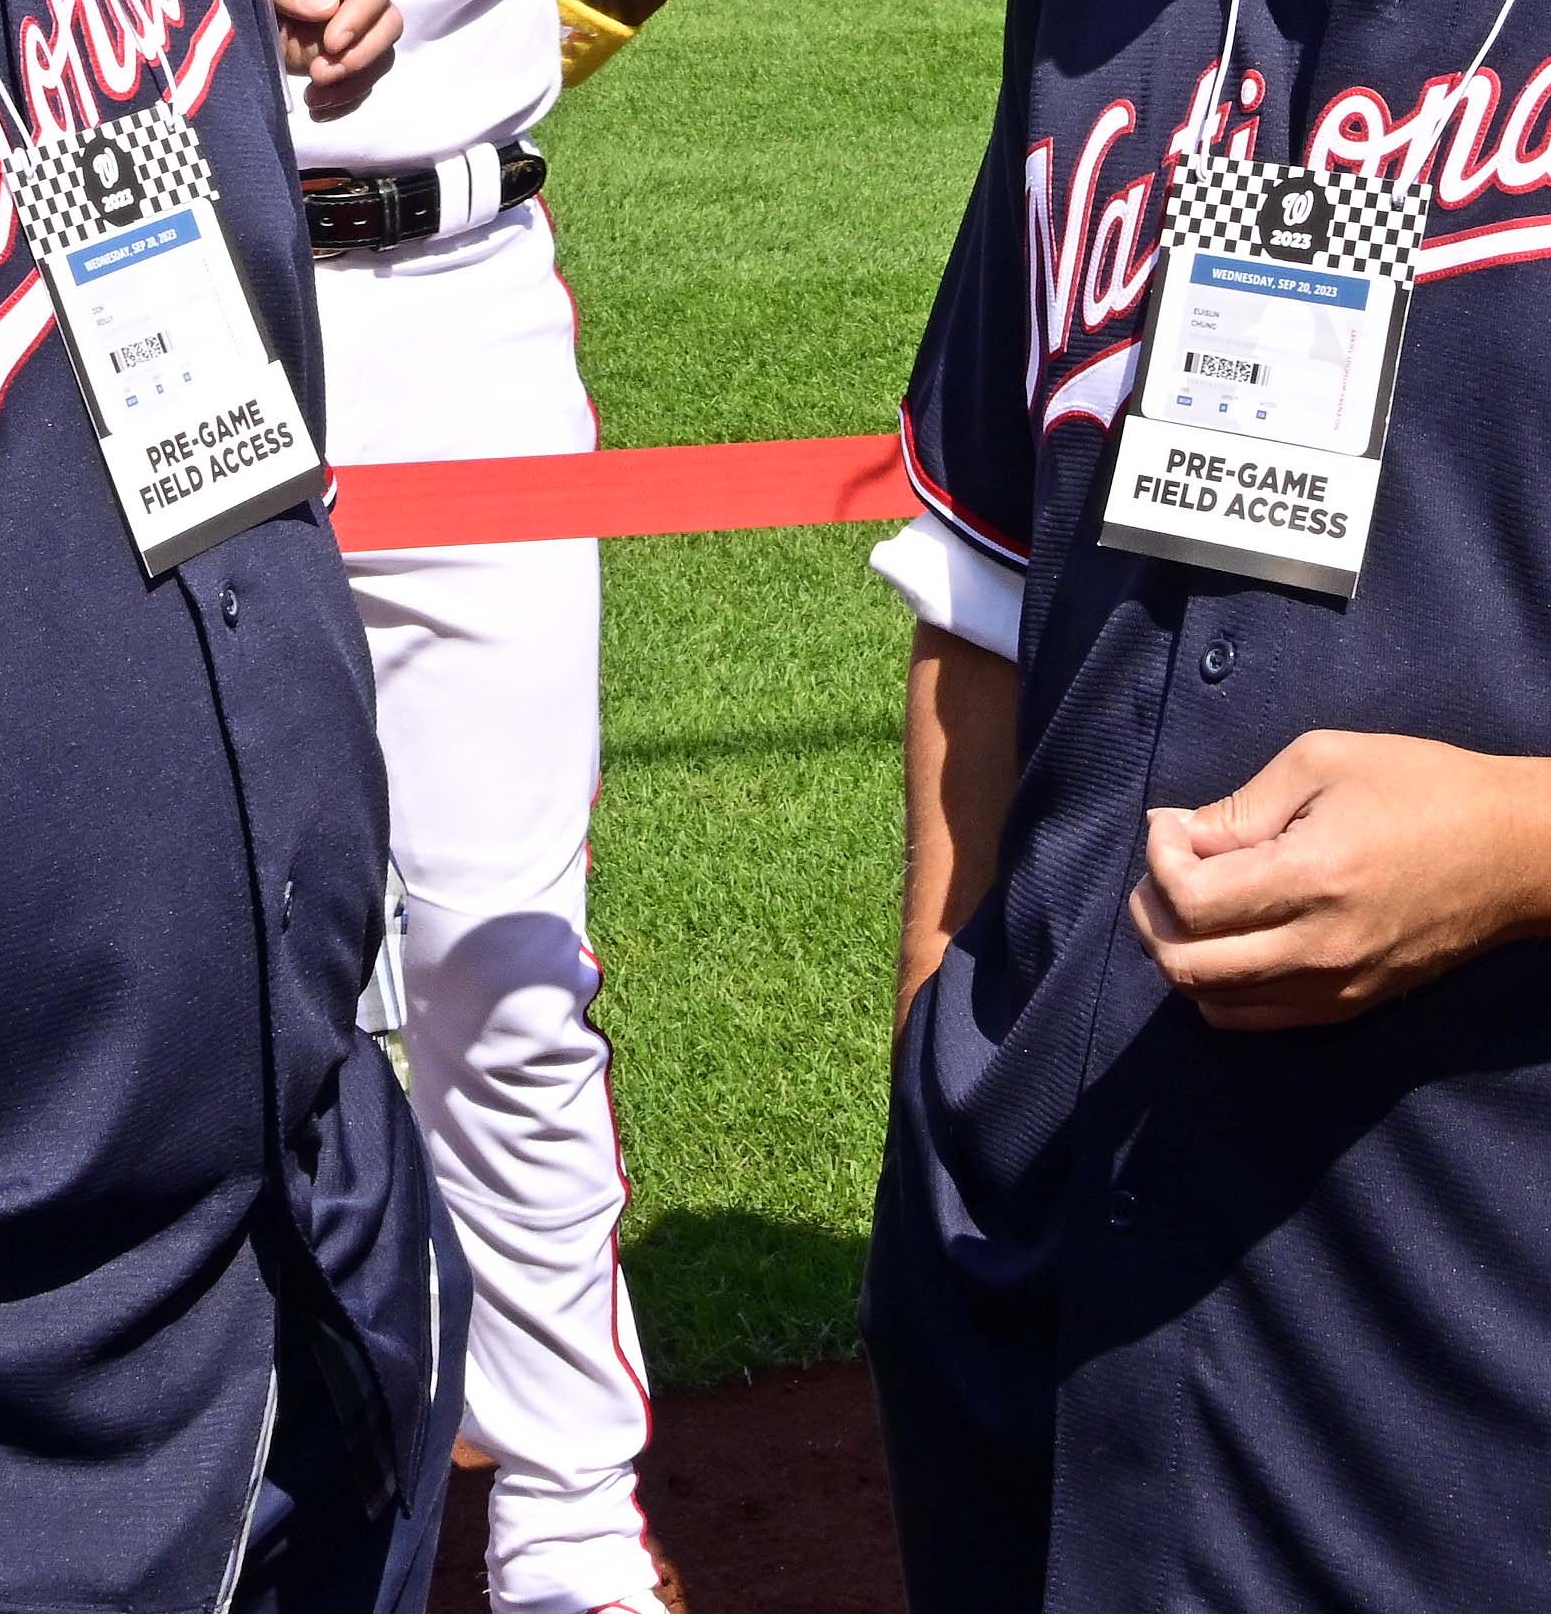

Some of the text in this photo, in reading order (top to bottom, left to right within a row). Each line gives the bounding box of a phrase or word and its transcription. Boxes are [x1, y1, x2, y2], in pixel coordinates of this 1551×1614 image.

[101, 188, 135, 213] 2023
[131, 240, 146, 254] SEP
[1270, 229, 1313, 251] 2023
[1212, 268, 1338, 298] WEDNESDAY, SEP 20, 2023
[145, 399, 265, 474] PRE-GAME
[138, 422, 295, 515] FIELD ACCESS
[1165, 448, 1329, 503] PRE-GAME
[1133, 473, 1349, 539] FIELD ACCESS
